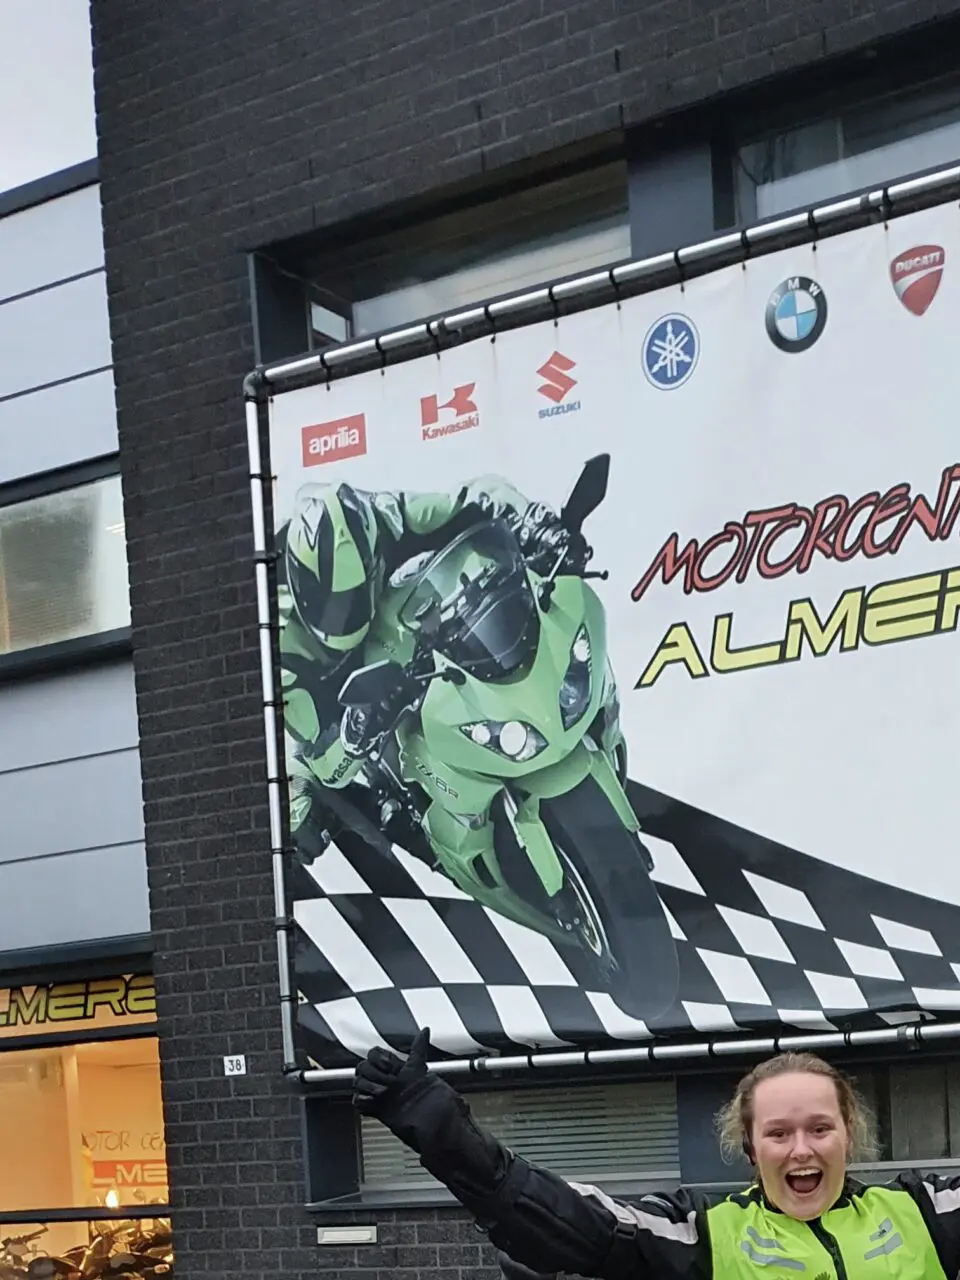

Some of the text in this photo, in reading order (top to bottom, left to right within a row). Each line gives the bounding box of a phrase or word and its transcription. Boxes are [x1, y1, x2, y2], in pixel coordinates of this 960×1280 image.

[895, 252, 941, 273] DUCATI
[770, 277, 822, 307] BMW
[538, 400, 581, 419] SUZUKI
[308, 426, 360, 456] aprilia
[422, 414, 479, 441] Kawasaki
[0, 975, 156, 1027] MERE
[228, 1059, 242, 1072] 38
